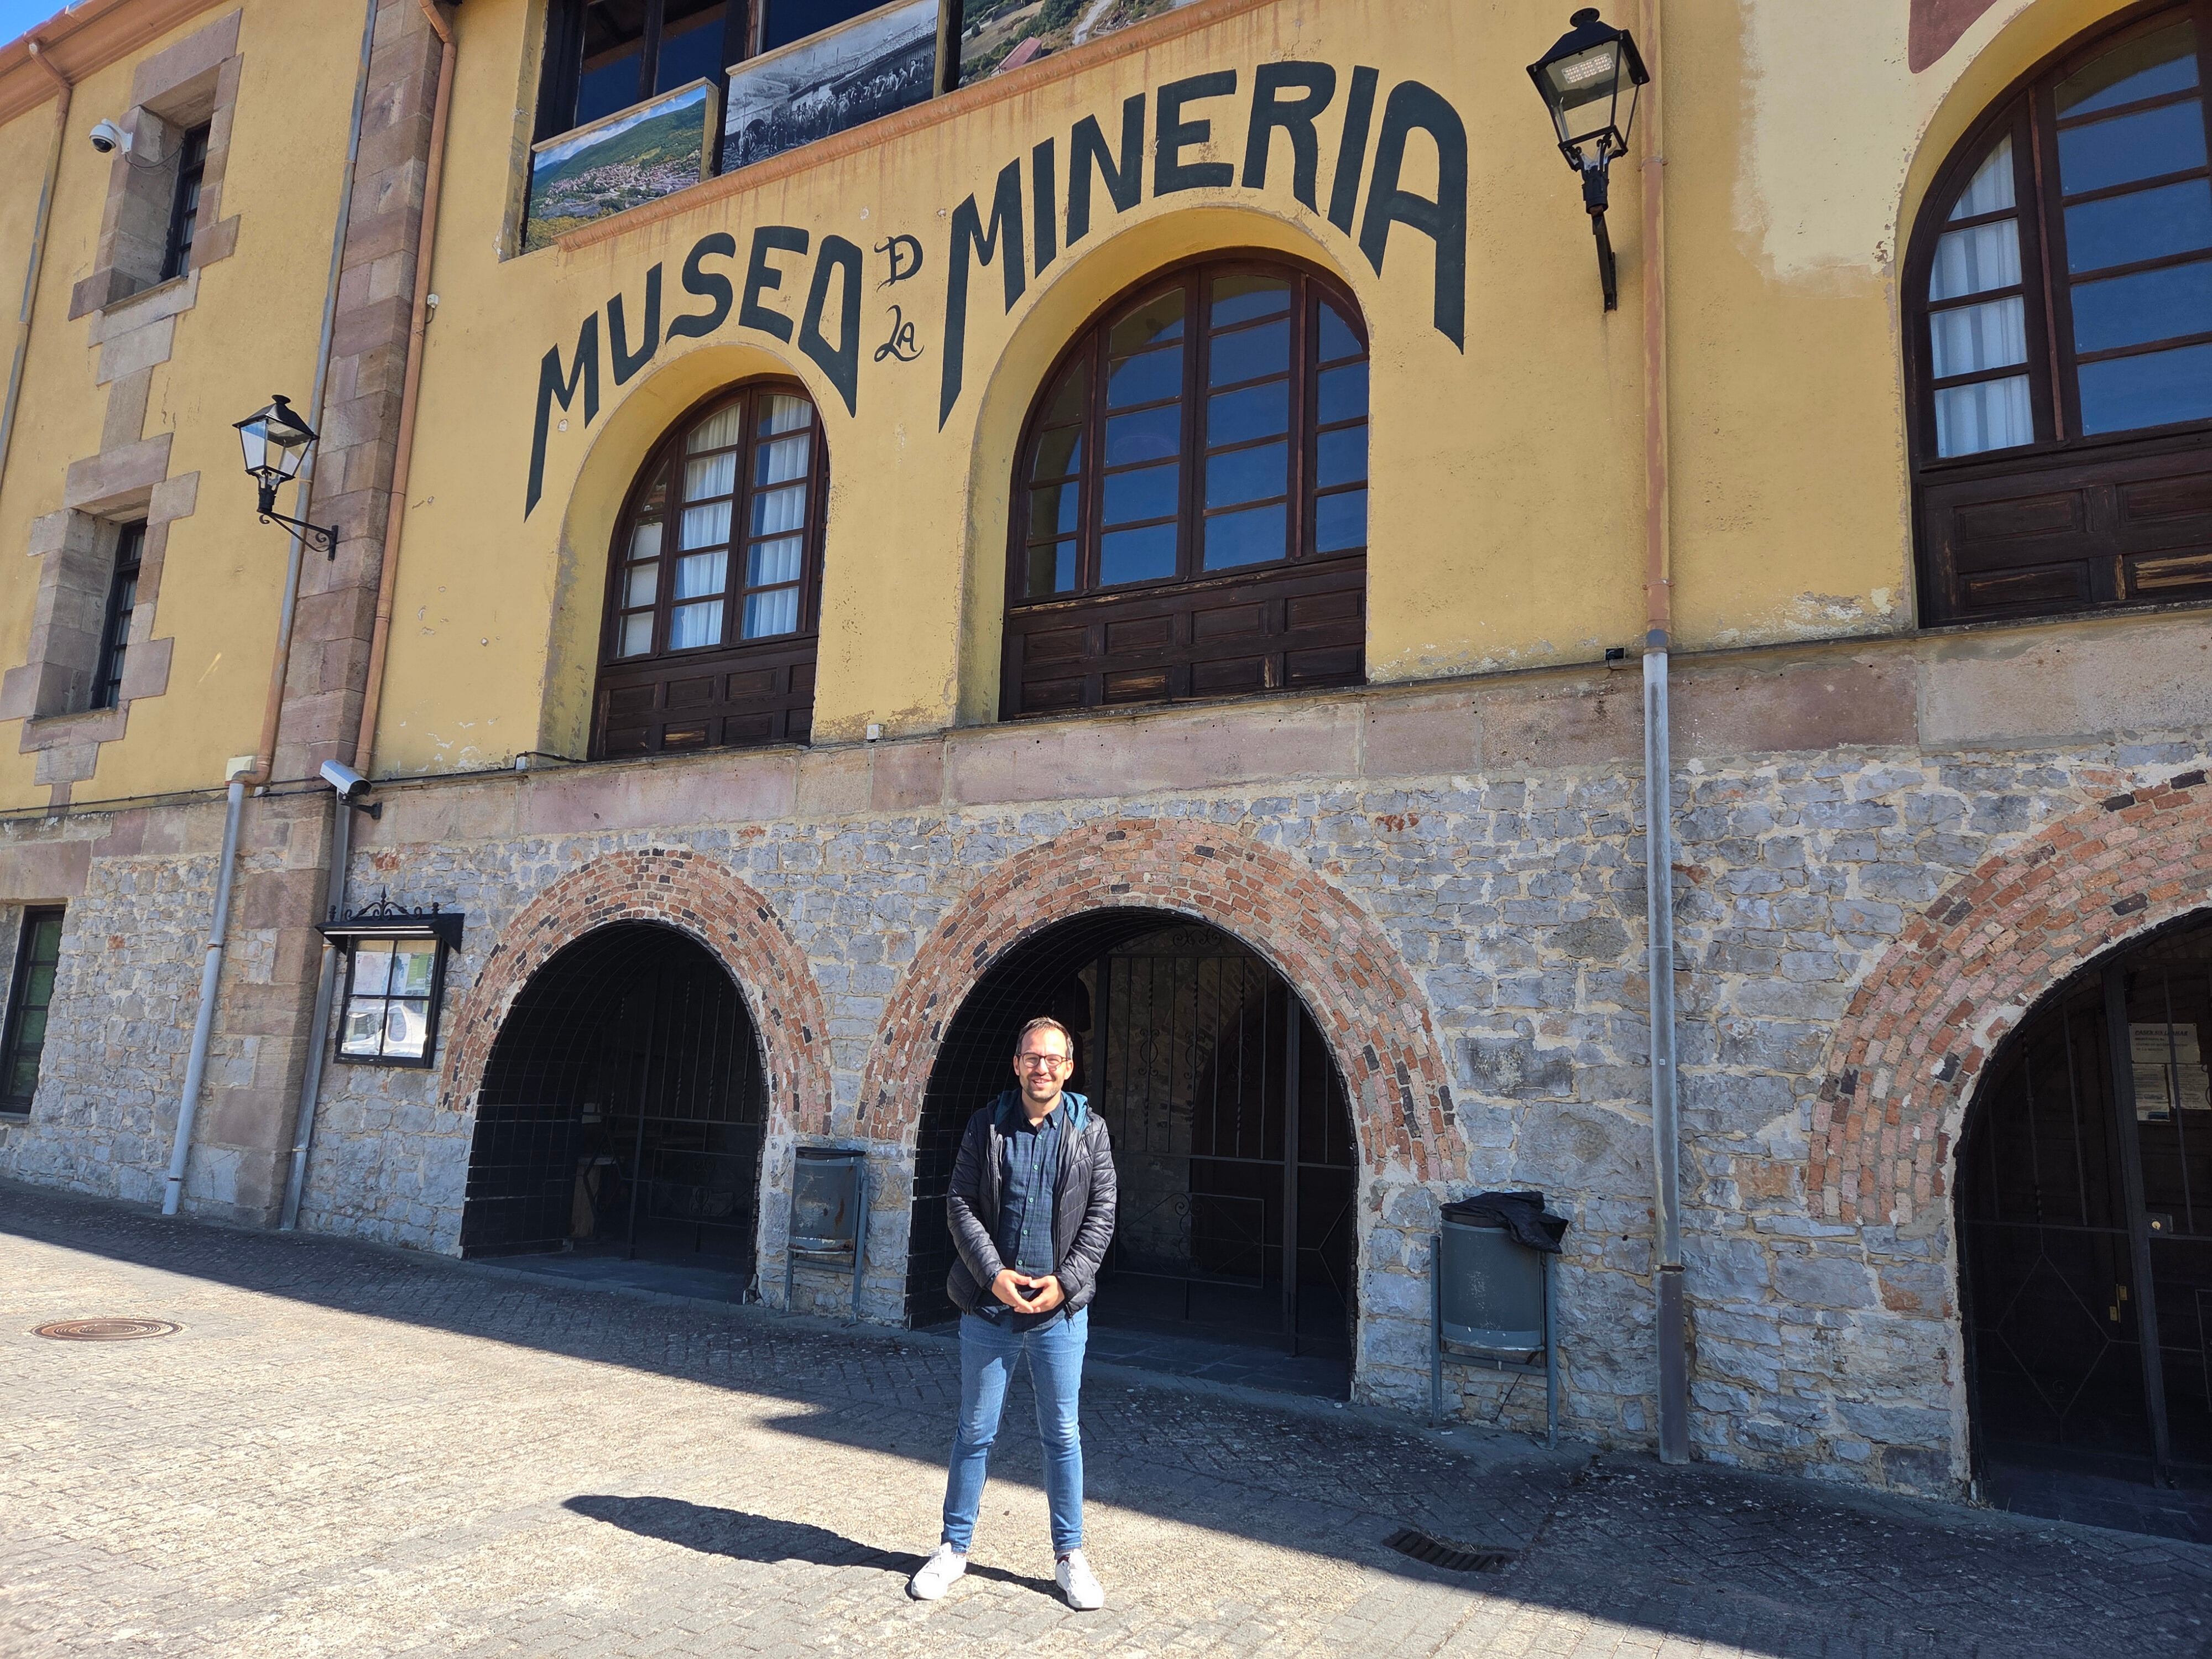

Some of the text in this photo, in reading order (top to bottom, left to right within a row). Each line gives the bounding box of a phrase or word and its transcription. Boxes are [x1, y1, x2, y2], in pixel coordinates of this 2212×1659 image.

[525, 226, 863, 521] MUSEO
[874, 304, 925, 362] LA
[938, 60, 1468, 432] MINERIA
